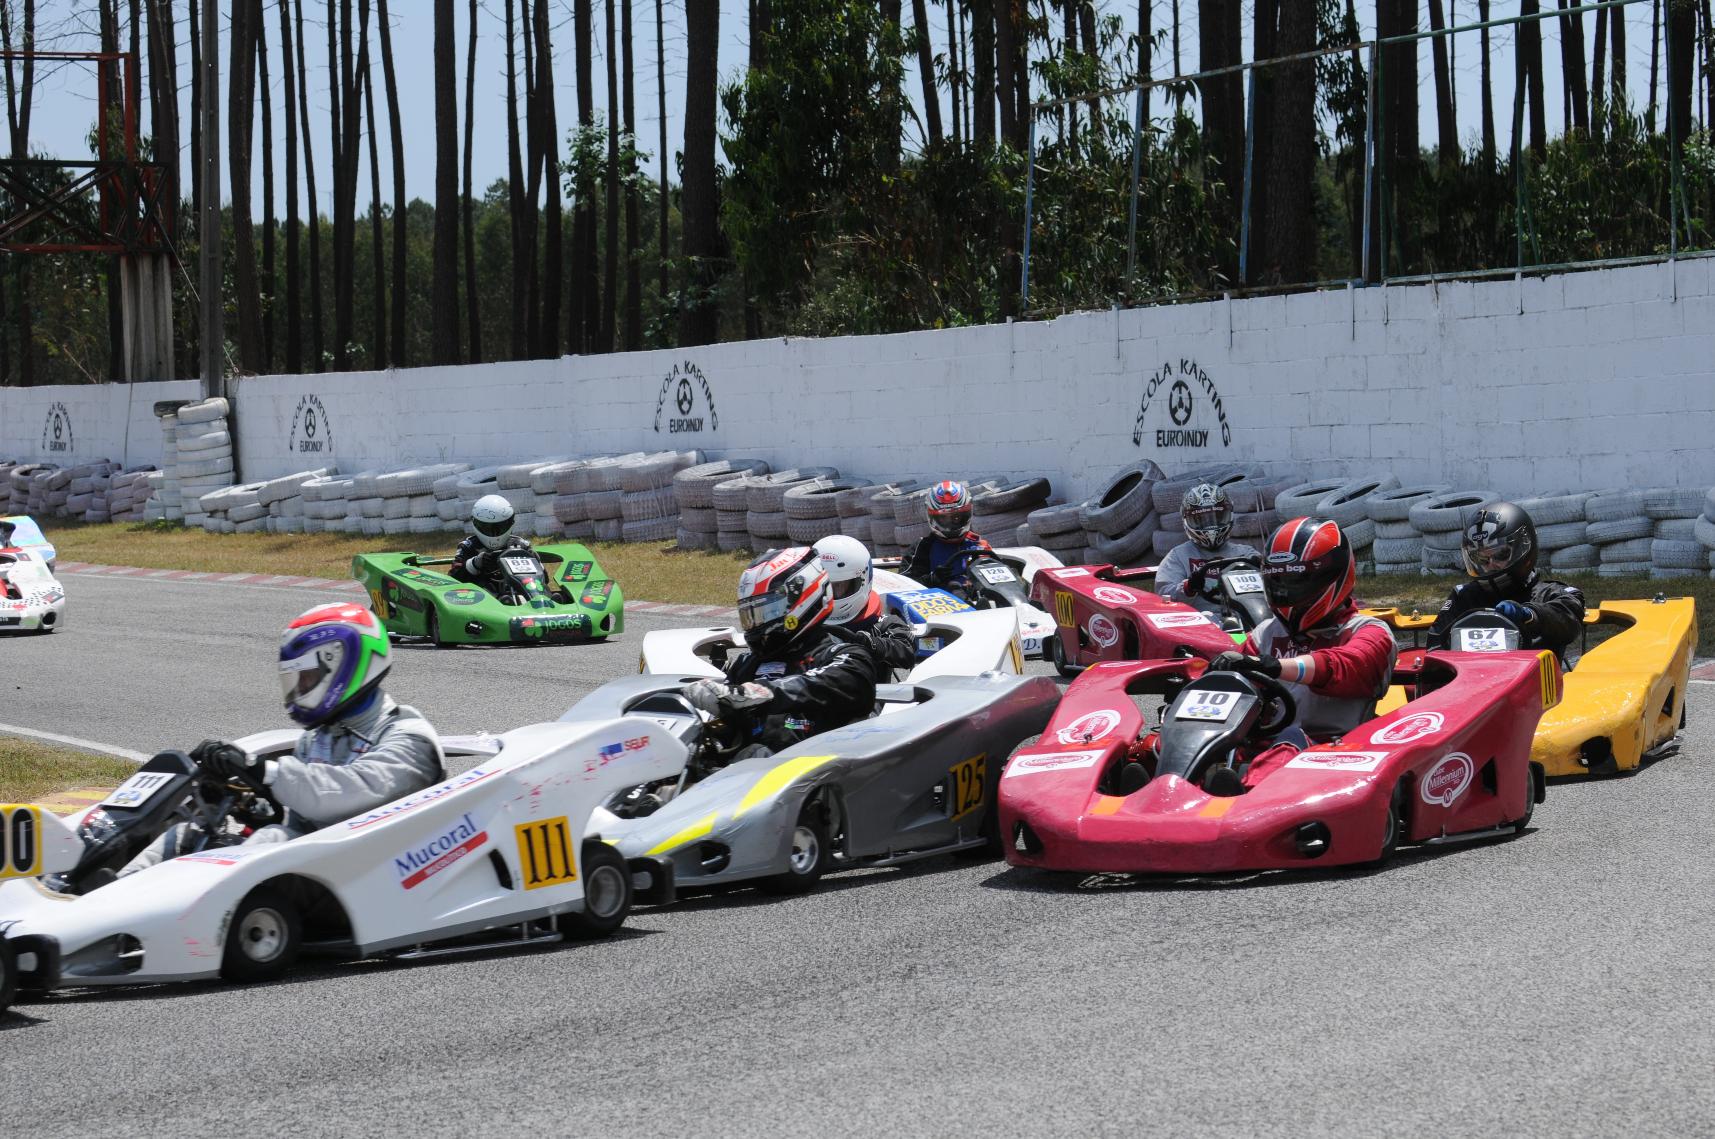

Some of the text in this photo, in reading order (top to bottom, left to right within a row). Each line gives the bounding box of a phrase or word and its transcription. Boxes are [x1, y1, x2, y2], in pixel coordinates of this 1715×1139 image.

[654, 360, 718, 432] ESCOLA KARTING
[1133, 358, 1231, 447] ESCOLA KARTING
[669, 418, 703, 433] EUROINDY
[1156, 429, 1208, 447] EUROINDY
[1286, 564, 1306, 573] bcp
[1056, 594, 1073, 626] 100
[545, 618, 582, 634] JOGOS
[1468, 629, 1498, 640] 67
[1197, 692, 1230, 706] 10
[131, 774, 167, 789] 111
[951, 760, 986, 816] 125
[1429, 766, 1465, 790] Millennium
[394, 812, 478, 877] Mucoral
[522, 822, 575, 884] 111
